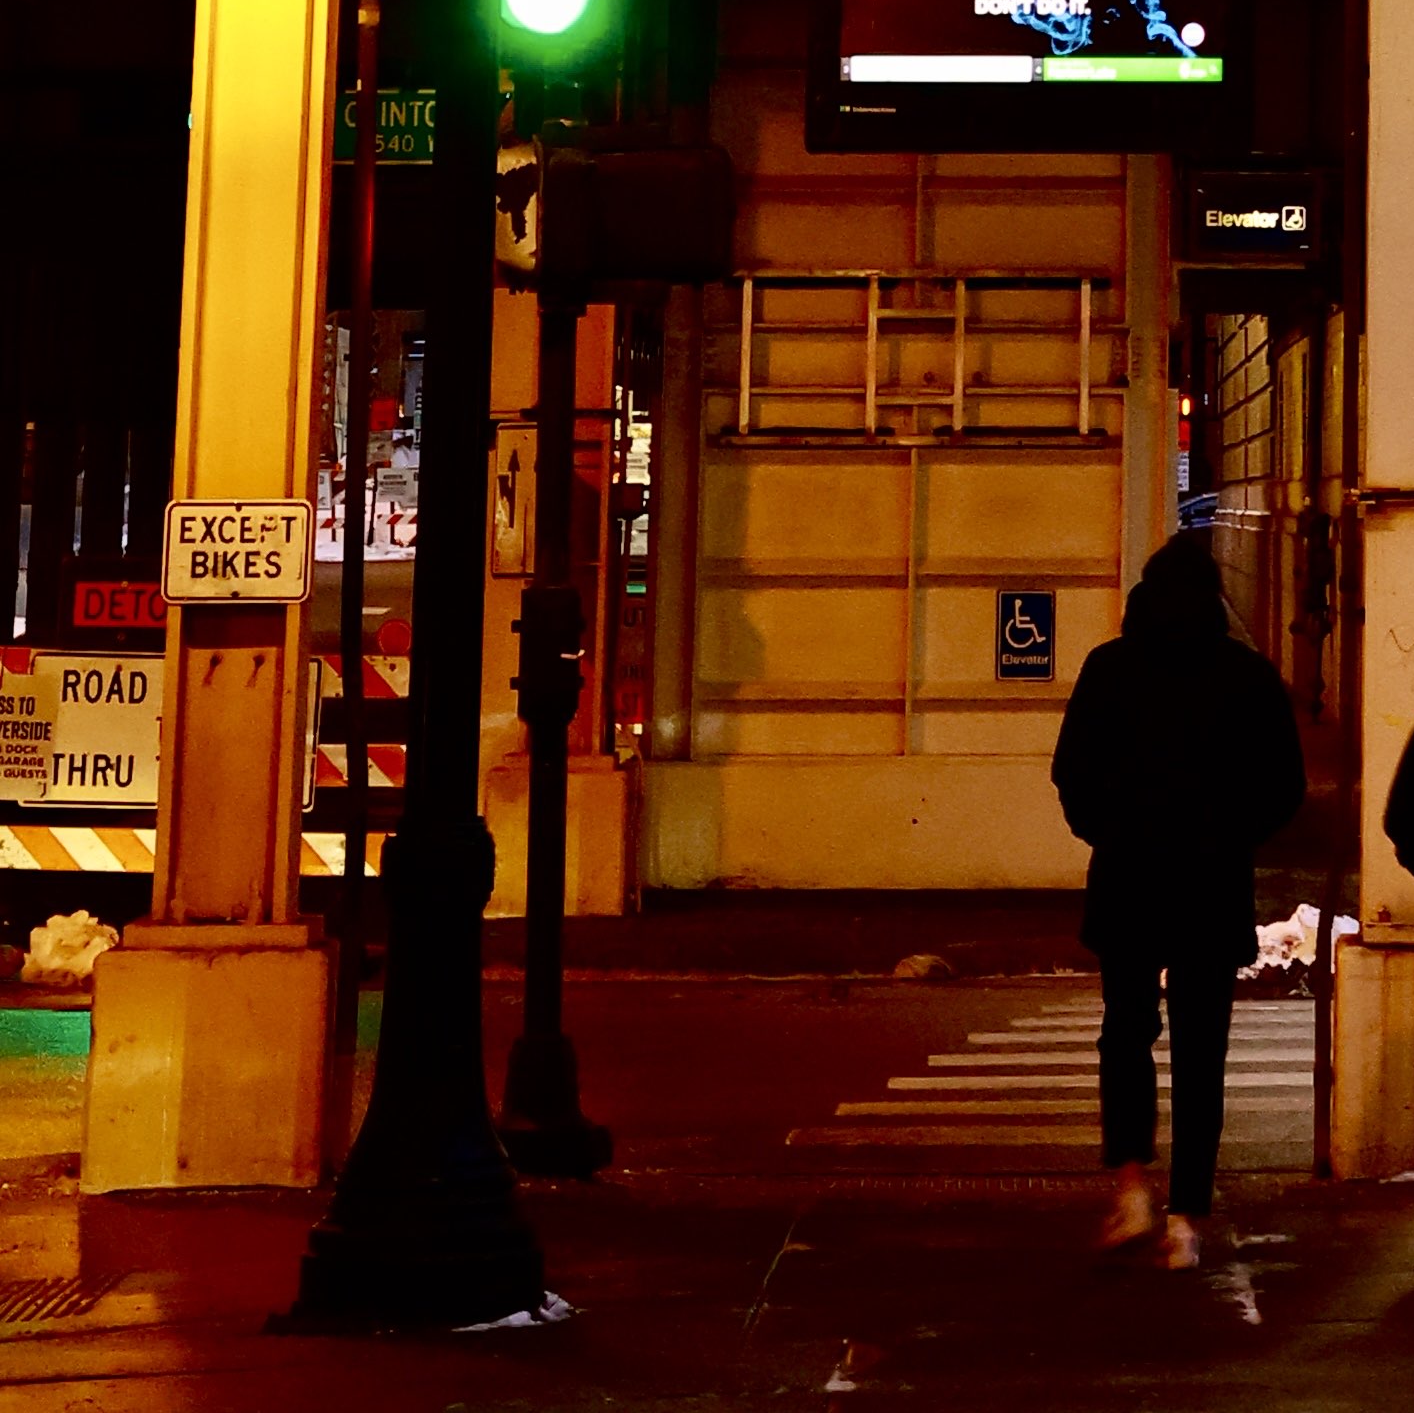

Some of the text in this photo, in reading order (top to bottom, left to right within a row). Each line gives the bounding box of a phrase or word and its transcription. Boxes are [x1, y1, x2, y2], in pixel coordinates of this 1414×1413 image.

[344, 101, 435, 127] CINTO
[376, 134, 415, 152] 540
[1206, 210, 1279, 228] Elevator
[190, 550, 282, 579] BIKES
[84, 588, 168, 621] DETO
[1002, 654, 1049, 665] Elevator
[62, 669, 148, 704] ROAD
[19, 696, 36, 716] TO
[5, 744, 38, 754] DOCK
[52, 753, 135, 788] THRU
